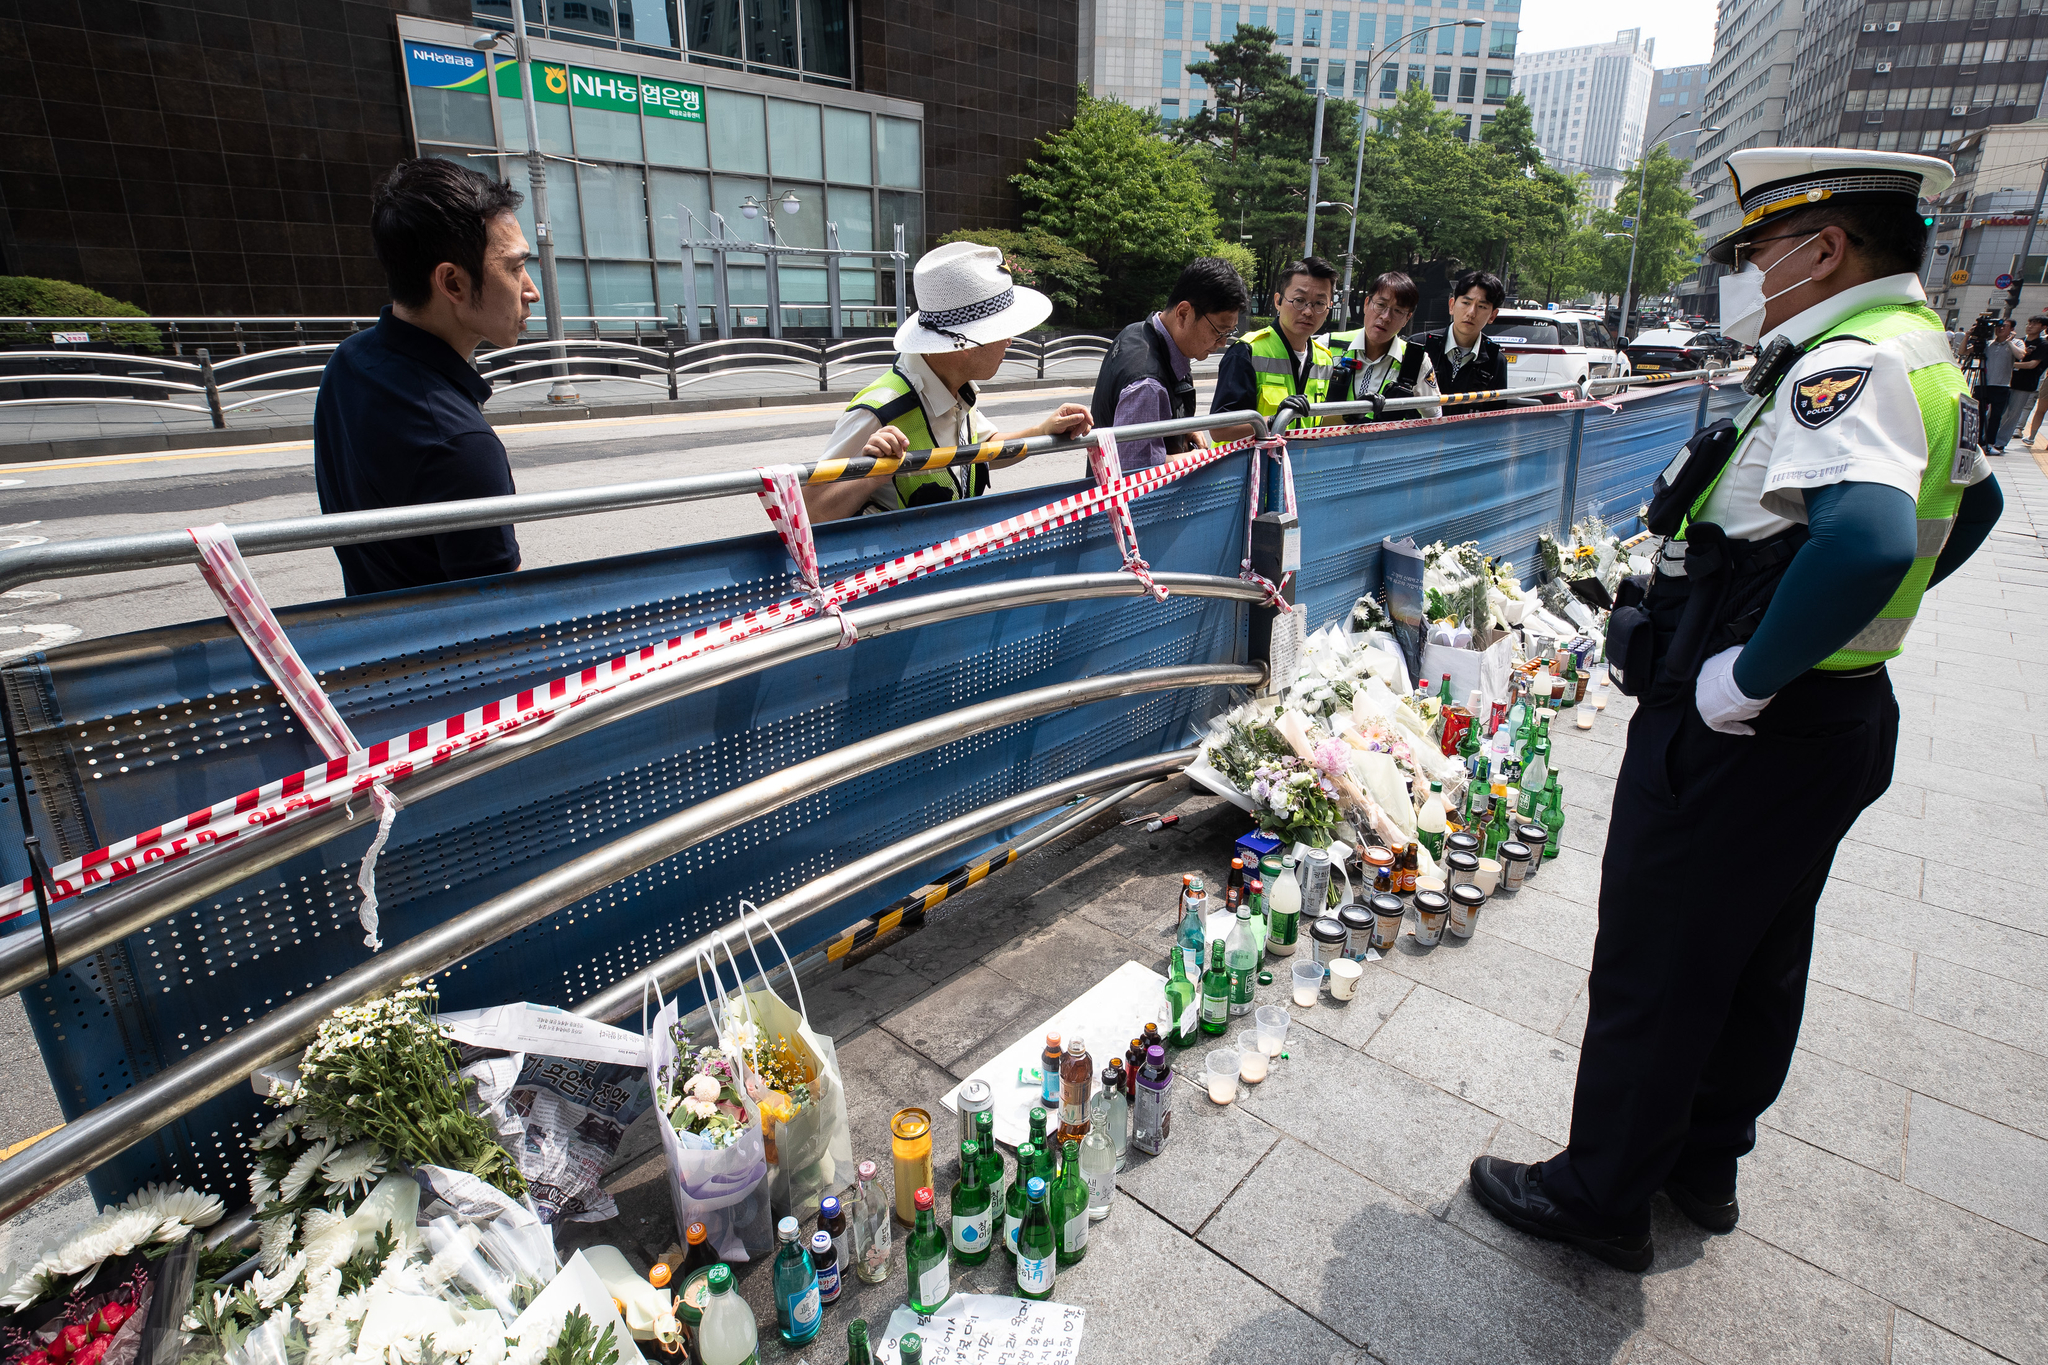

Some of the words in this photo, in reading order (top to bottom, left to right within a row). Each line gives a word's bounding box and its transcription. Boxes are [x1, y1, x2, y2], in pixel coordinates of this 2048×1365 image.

[413, 50, 474, 67] NH농협금융
[572, 73, 700, 111] NH농협은행
[1806, 406, 1834, 416] POLICE
